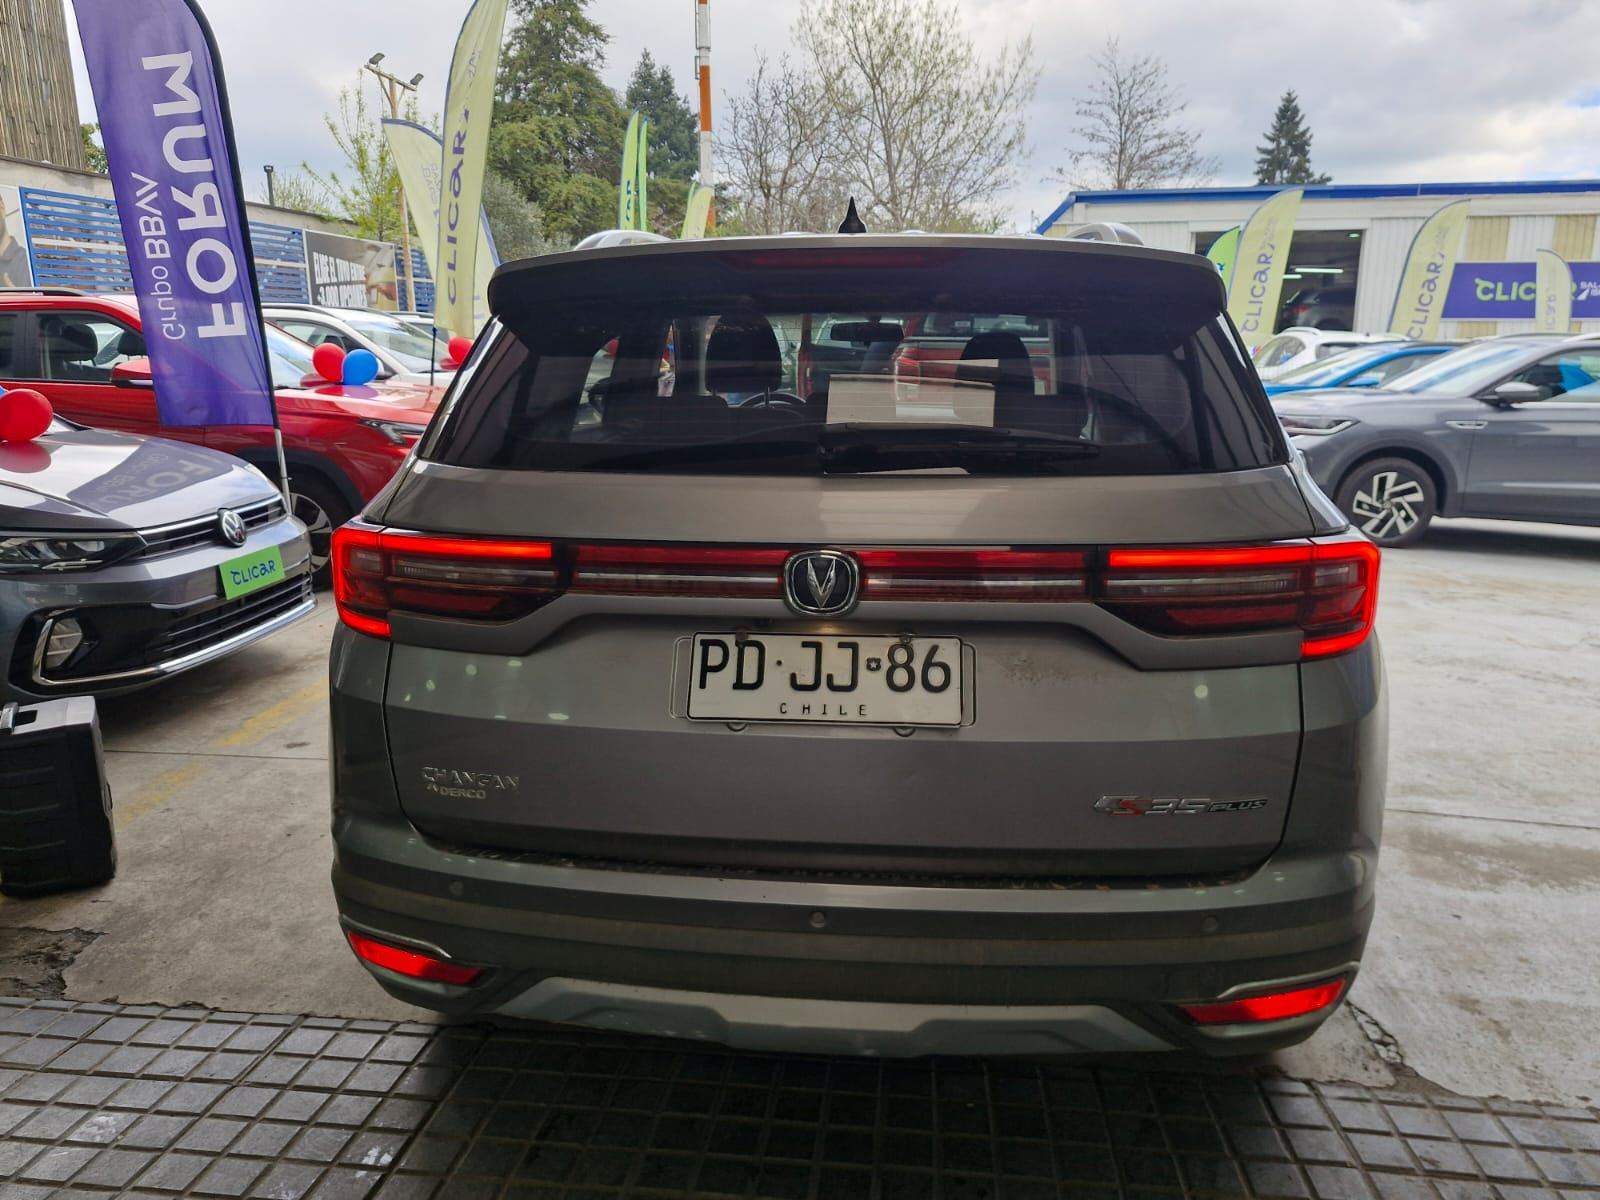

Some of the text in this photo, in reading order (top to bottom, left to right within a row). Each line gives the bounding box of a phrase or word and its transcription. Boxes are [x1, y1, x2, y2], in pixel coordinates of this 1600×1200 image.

[885, 643, 952, 693] 86
[779, 702, 867, 716] CHILE
[1208, 799, 1268, 813] PLUS
